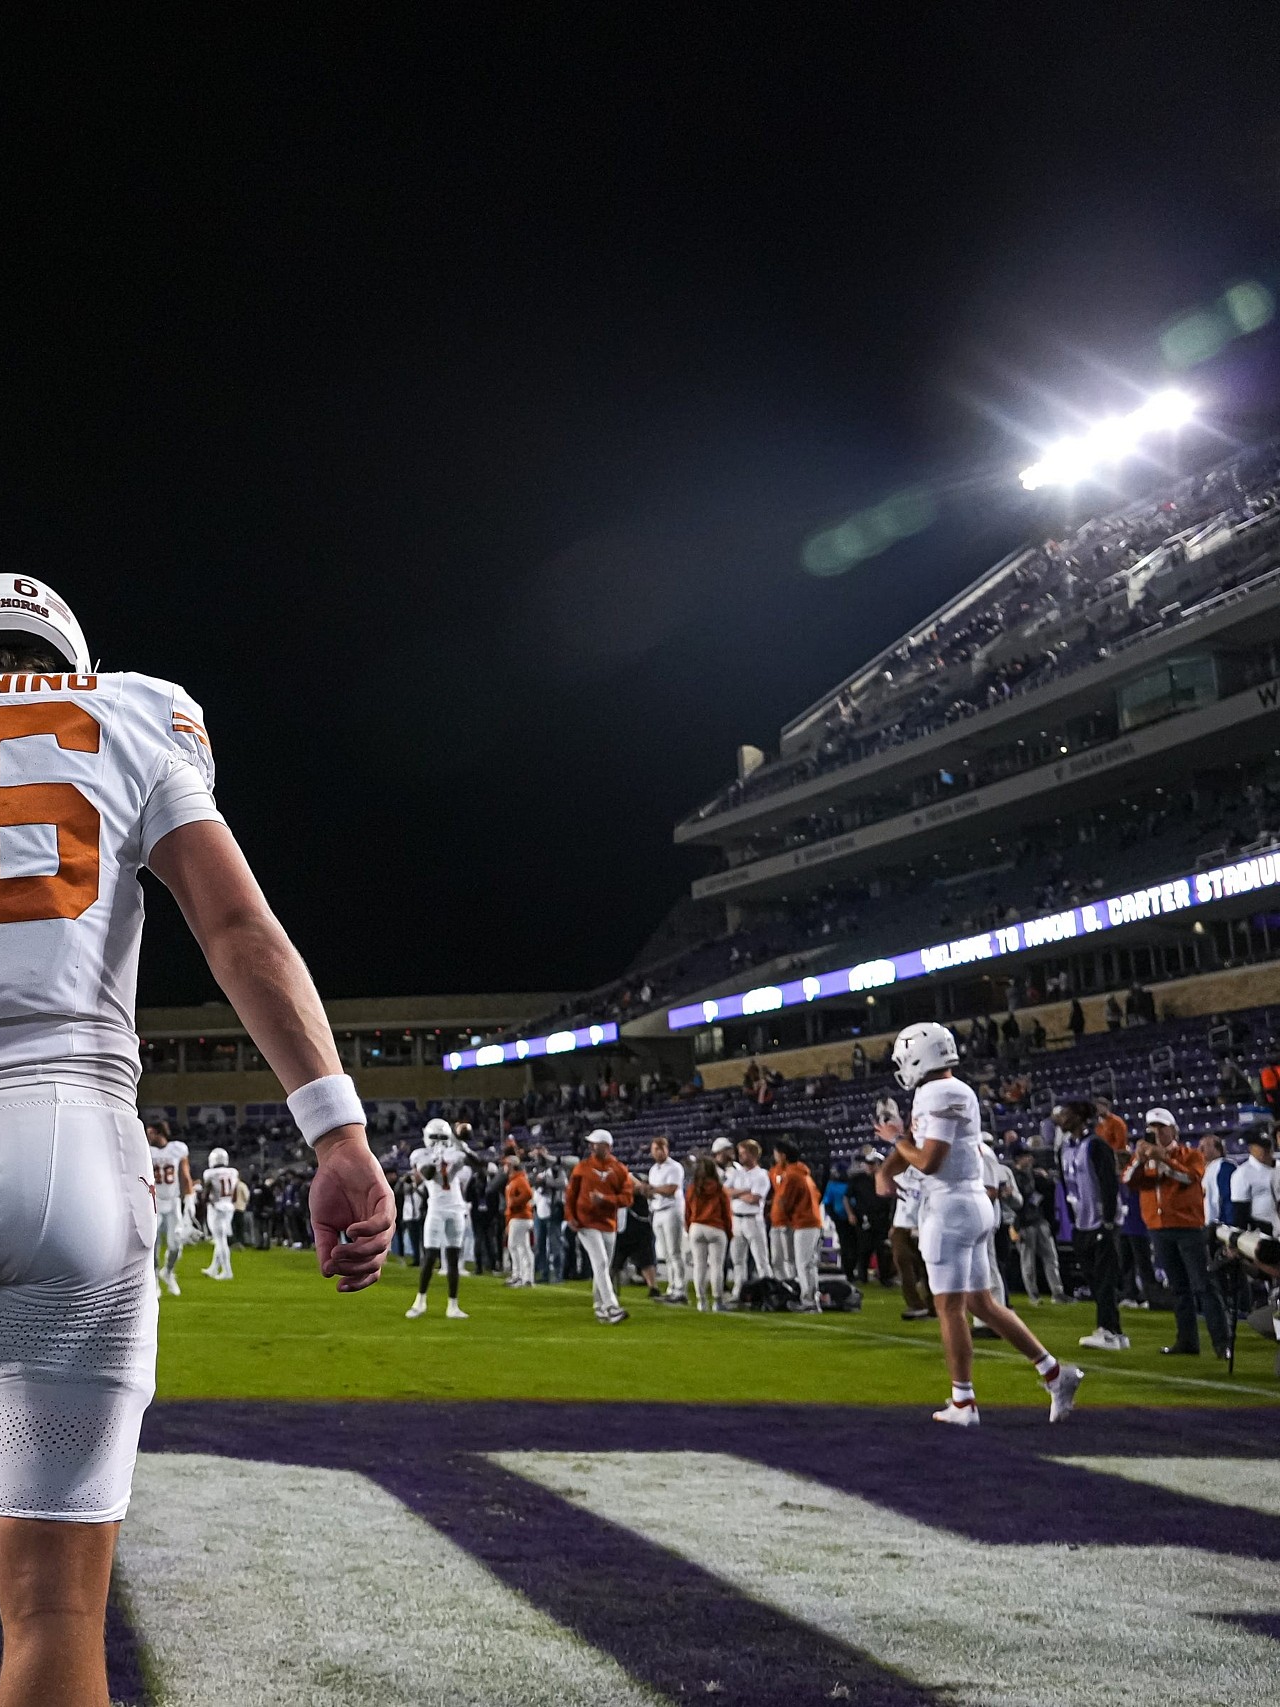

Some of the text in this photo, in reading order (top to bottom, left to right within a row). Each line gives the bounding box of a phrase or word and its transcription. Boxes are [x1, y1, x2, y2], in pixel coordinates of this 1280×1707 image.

[996, 926, 1019, 954] TO
[1023, 910, 1077, 948] AMON
[1107, 879, 1191, 926] CARTER
